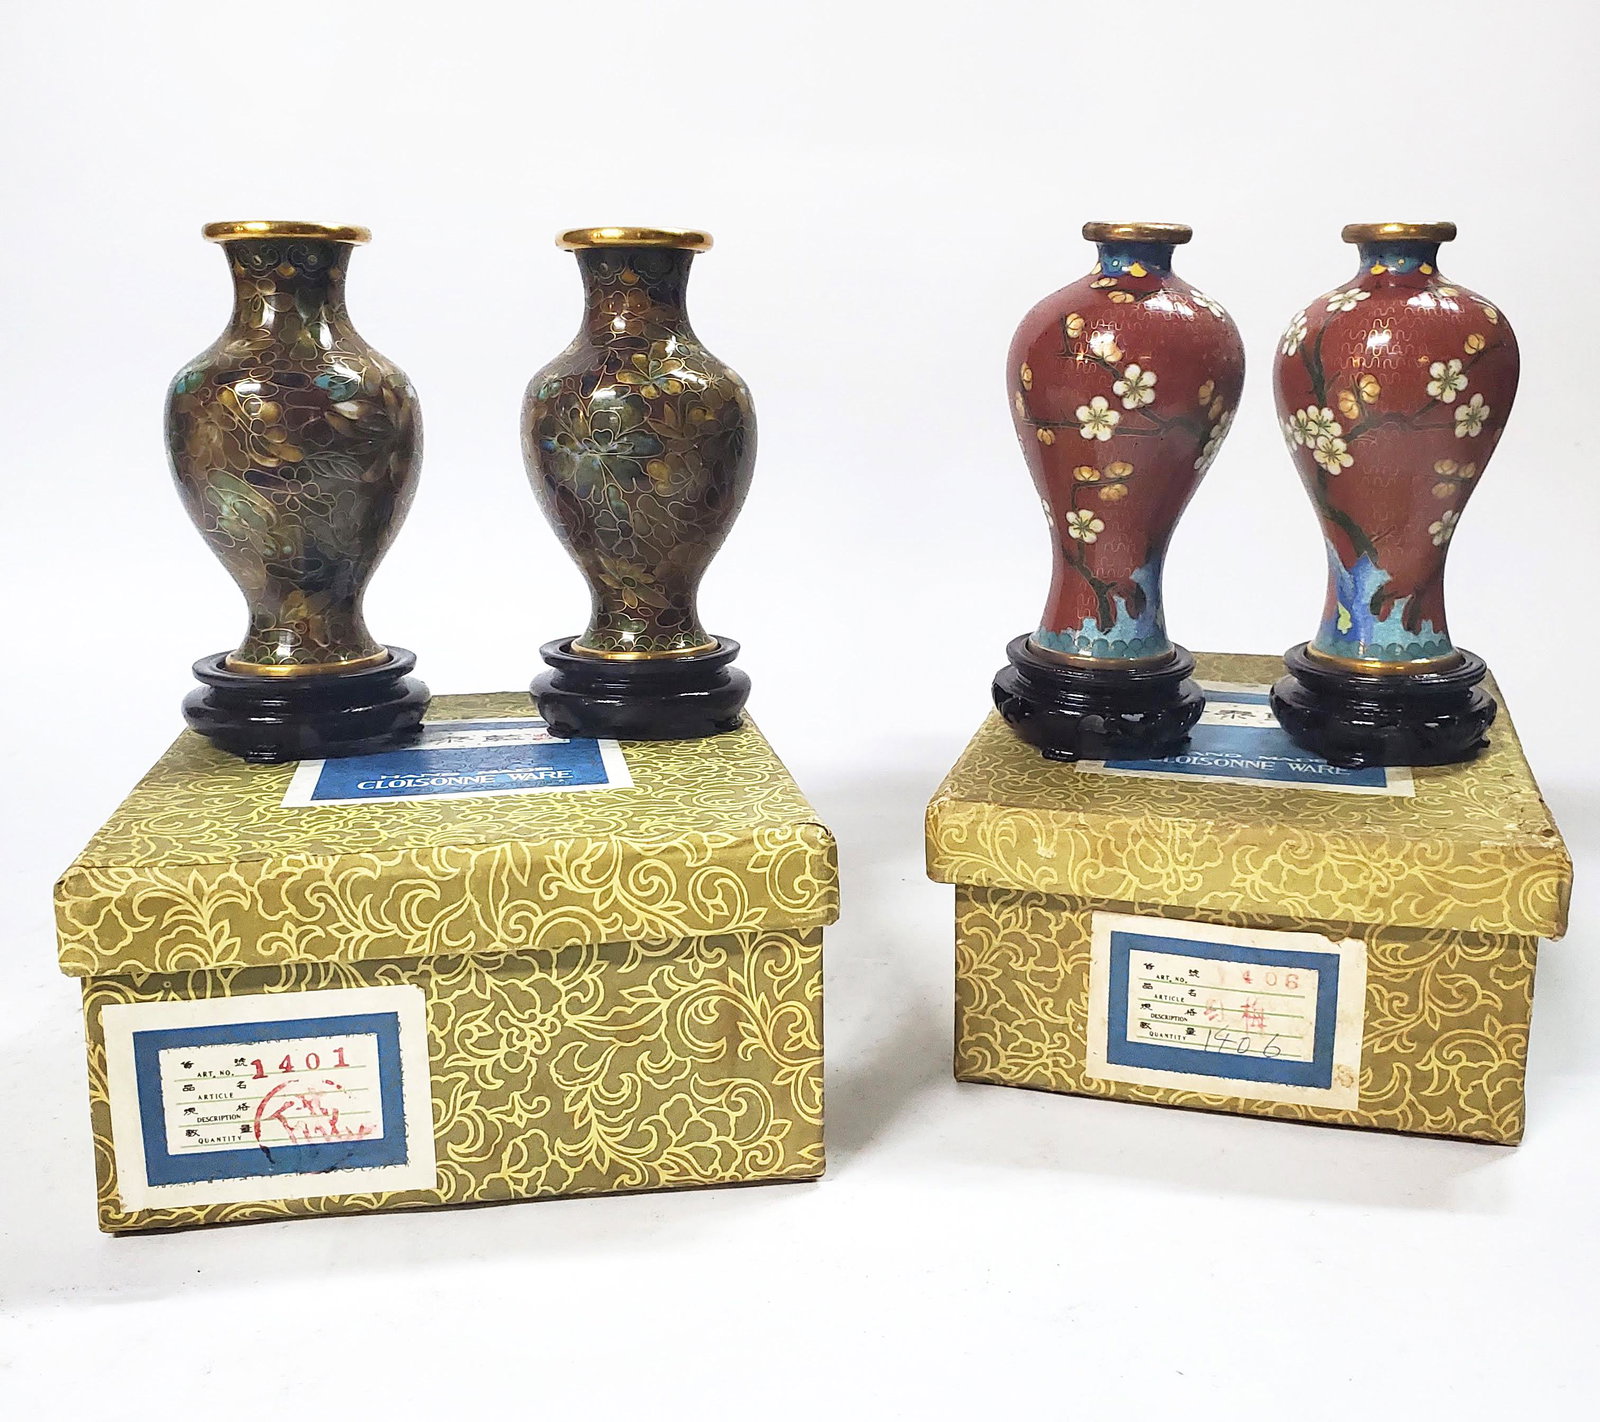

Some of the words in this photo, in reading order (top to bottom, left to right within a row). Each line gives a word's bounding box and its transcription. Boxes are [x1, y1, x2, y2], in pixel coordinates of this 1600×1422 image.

[1149, 755, 1275, 771] LOISONNE
[1287, 762, 1350, 776] WARE
[357, 775, 497, 790] CLOISONNE
[508, 770, 573, 782] WARE
[1156, 974, 1172, 984] ART.
[1174, 976, 1188, 985] NO.
[1154, 994, 1185, 1003] ARTICLE
[1150, 1013, 1188, 1022] DESCRIPTION
[1149, 1031, 1187, 1041] QUANTITY
[1205, 1025, 1281, 1057] 1406
[250, 1046, 350, 1080] 1401
[197, 1070, 216, 1079] ART.
[219, 1069, 235, 1077] NO.
[197, 1092, 234, 1101] ARTICLE
[196, 1113, 241, 1123] DESCRIPTION
[197, 1135, 243, 1145] QUANTITY
